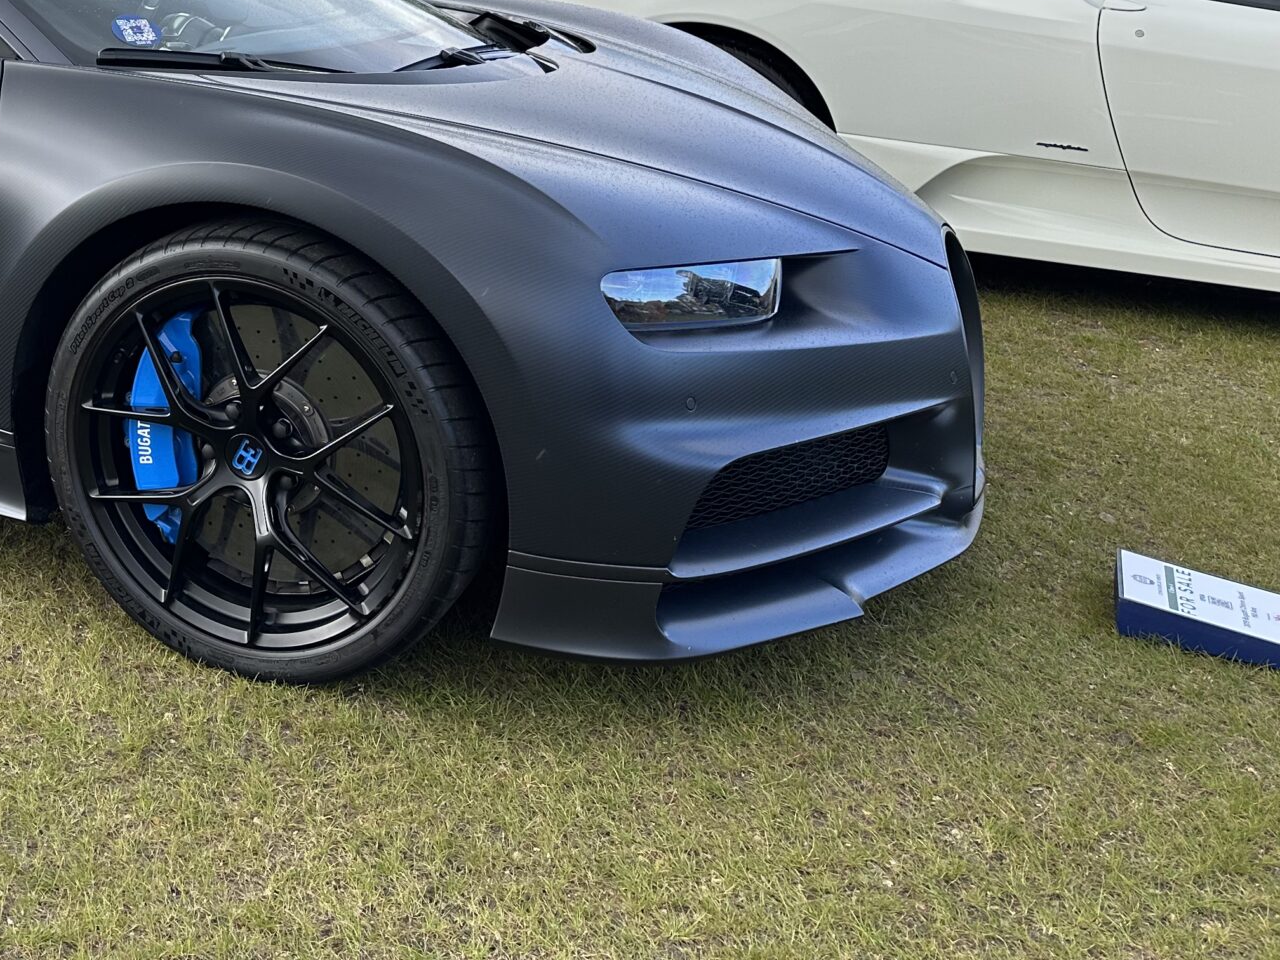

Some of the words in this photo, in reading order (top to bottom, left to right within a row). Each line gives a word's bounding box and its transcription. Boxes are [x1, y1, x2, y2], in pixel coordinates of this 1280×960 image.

[86, 297, 109, 329] Sport
[107, 285, 126, 303] Cup
[125, 277, 135, 288] 2
[336, 301, 408, 378] MICHELIN
[137, 420, 153, 465] BUGAT
[1175, 568, 1195, 595] SALE
[1179, 594, 1198, 617] FOR
